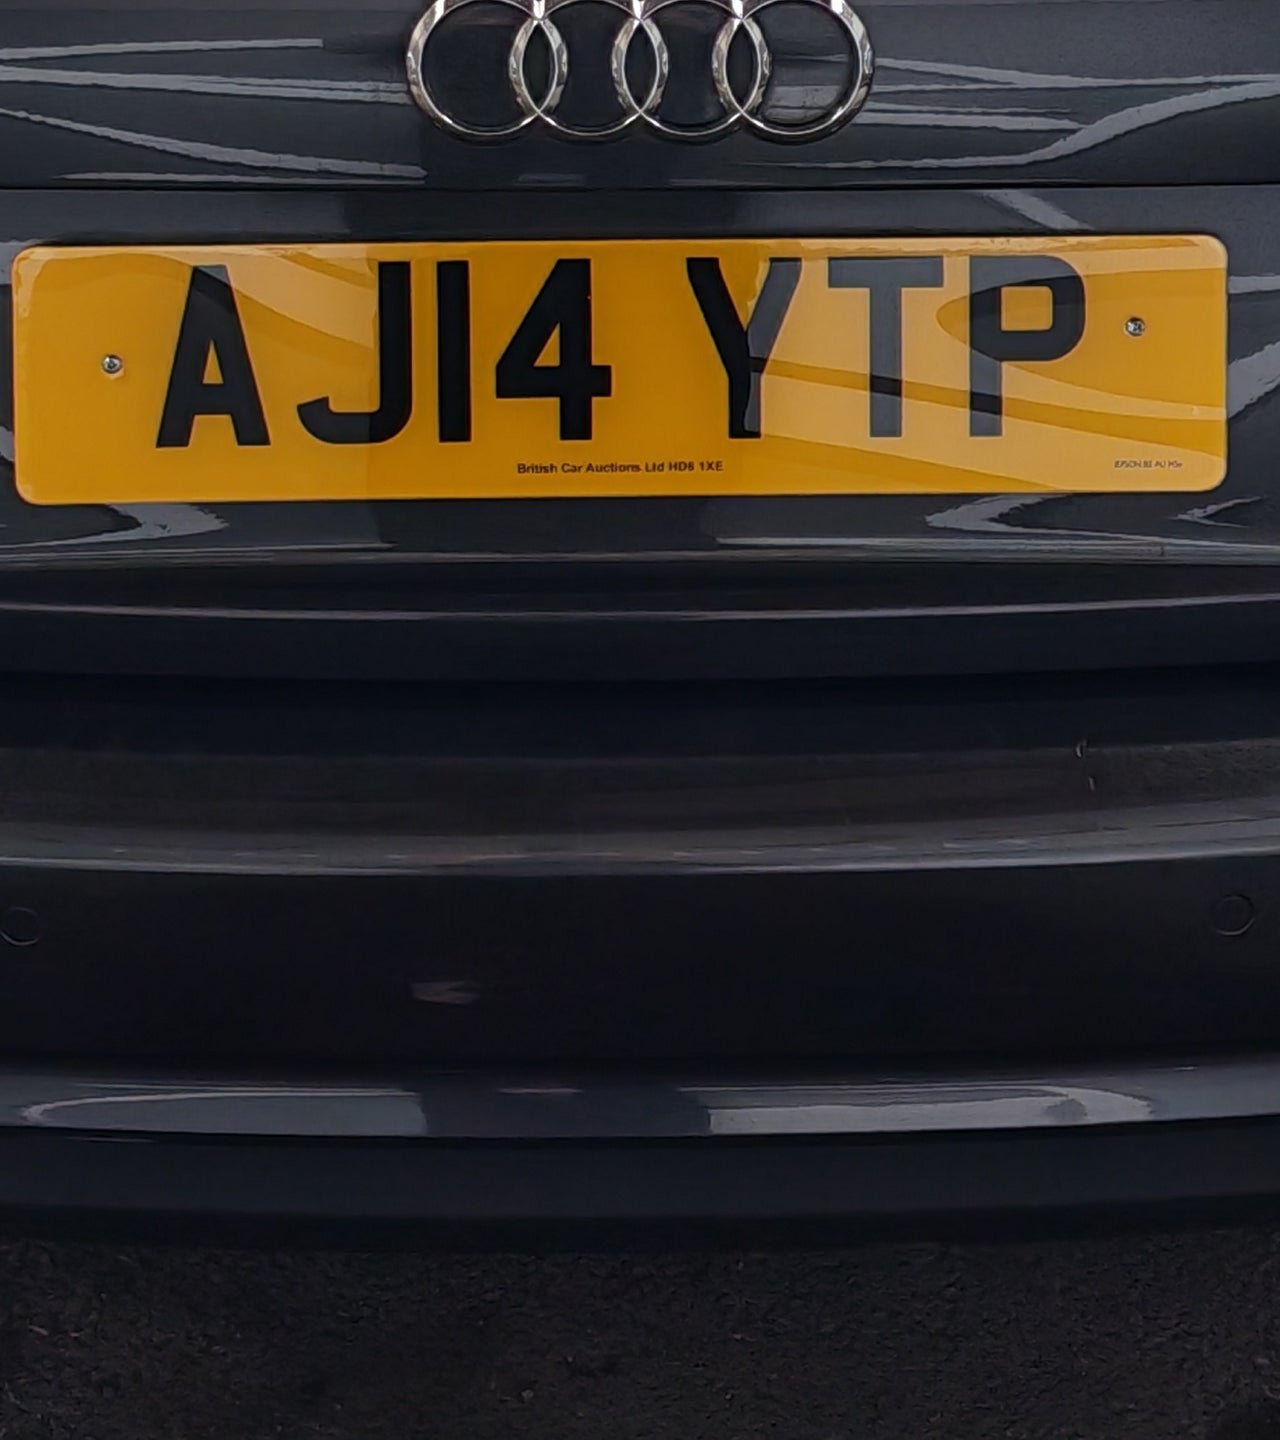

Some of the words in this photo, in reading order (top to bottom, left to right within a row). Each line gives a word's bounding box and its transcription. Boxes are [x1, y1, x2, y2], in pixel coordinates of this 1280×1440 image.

[156, 257, 612, 449] AJ14
[685, 254, 1086, 441] YTP
[517, 463, 558, 474] British
[561, 463, 583, 473] Car
[585, 462, 642, 473] Auctions
[644, 462, 665, 472] Ltd
